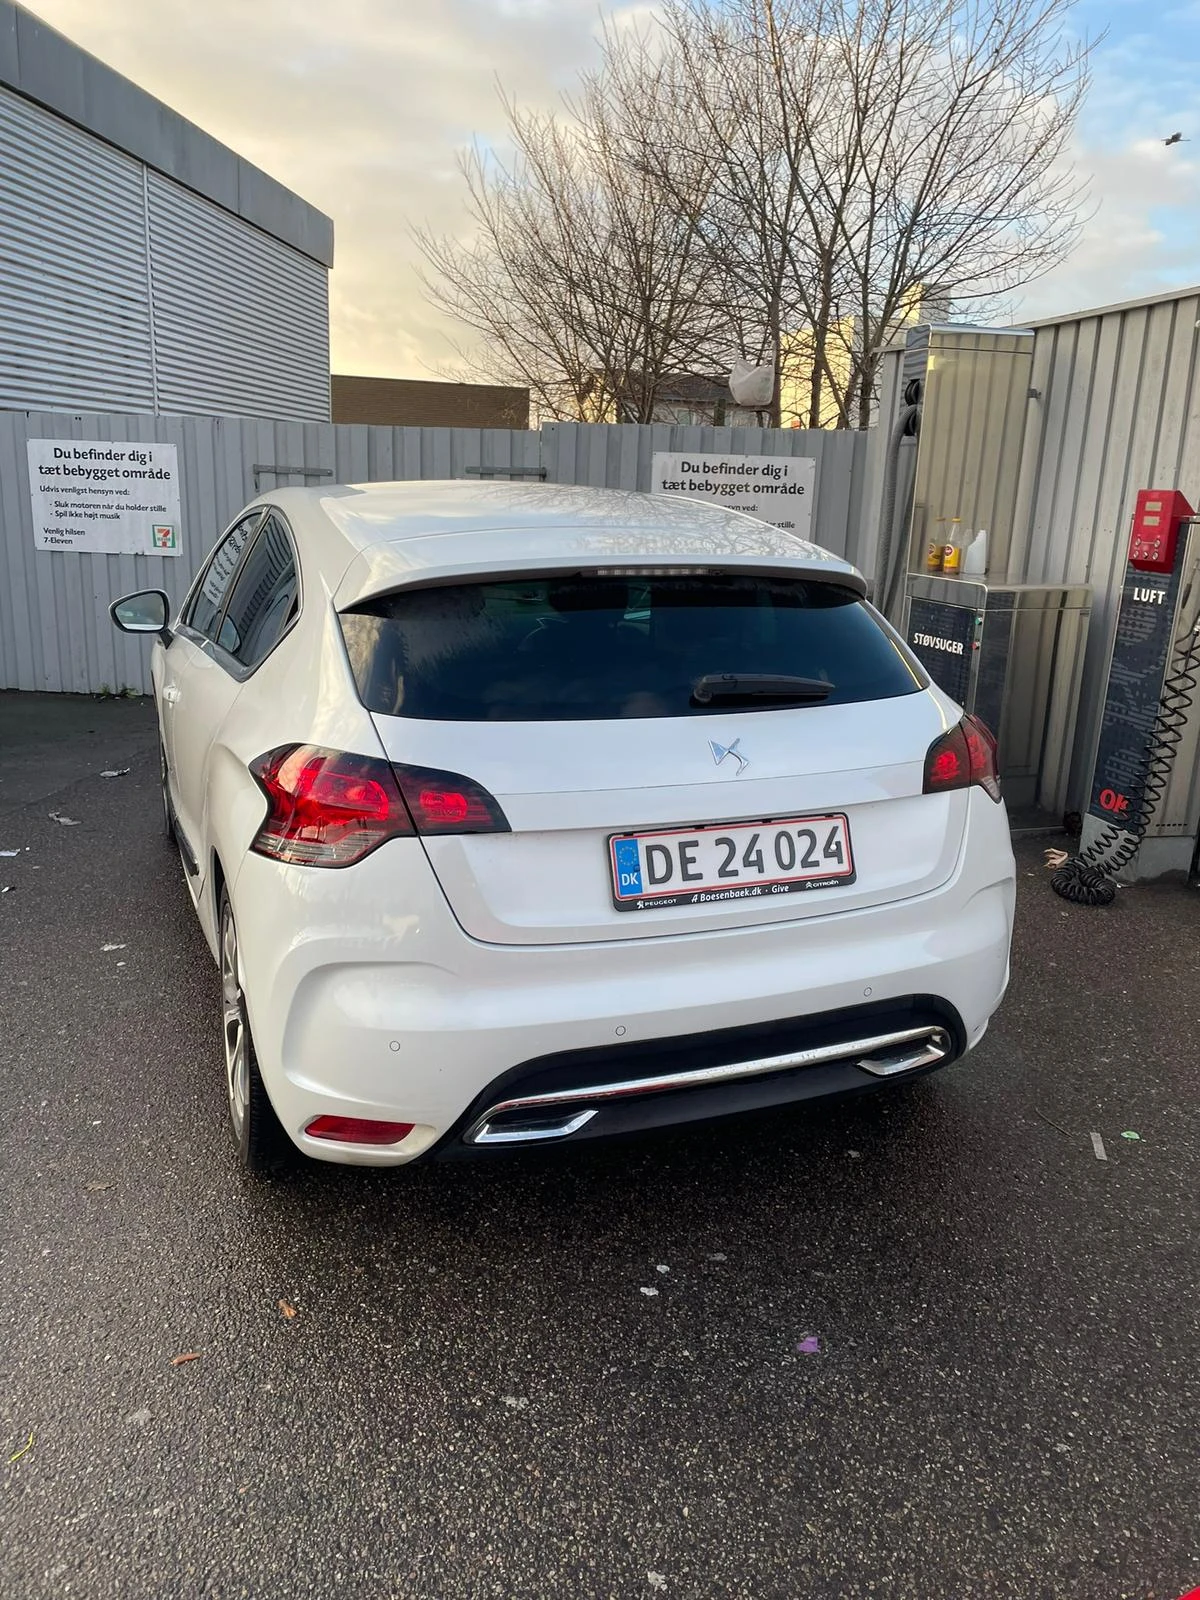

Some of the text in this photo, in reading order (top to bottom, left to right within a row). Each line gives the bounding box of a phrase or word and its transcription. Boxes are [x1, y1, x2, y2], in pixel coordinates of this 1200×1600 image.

[54, 448, 71, 459] Du
[74, 448, 125, 461] befinder
[128, 450, 147, 465] dig
[38, 465, 171, 480] tæt bebygget område
[681, 461, 788, 480] Du befinder dig i
[60, 486, 87, 496] venligst
[88, 487, 114, 496] hensyn
[662, 479, 805, 496] tæt bebygget område
[102, 502, 114, 510] når
[55, 511, 68, 519] Spil
[84, 512, 98, 520] højt
[44, 528, 85, 536] Venlig hilsen
[1133, 587, 1166, 604] LUFT
[914, 632, 964, 655] STØVSUGER
[645, 826, 844, 885] DE 24 024
[621, 872, 638, 886] DK
[700, 886, 762, 902] Boesenbaek.dk
[772, 885, 789, 893] Give
[644, 899, 677, 907] PEUGEOT
